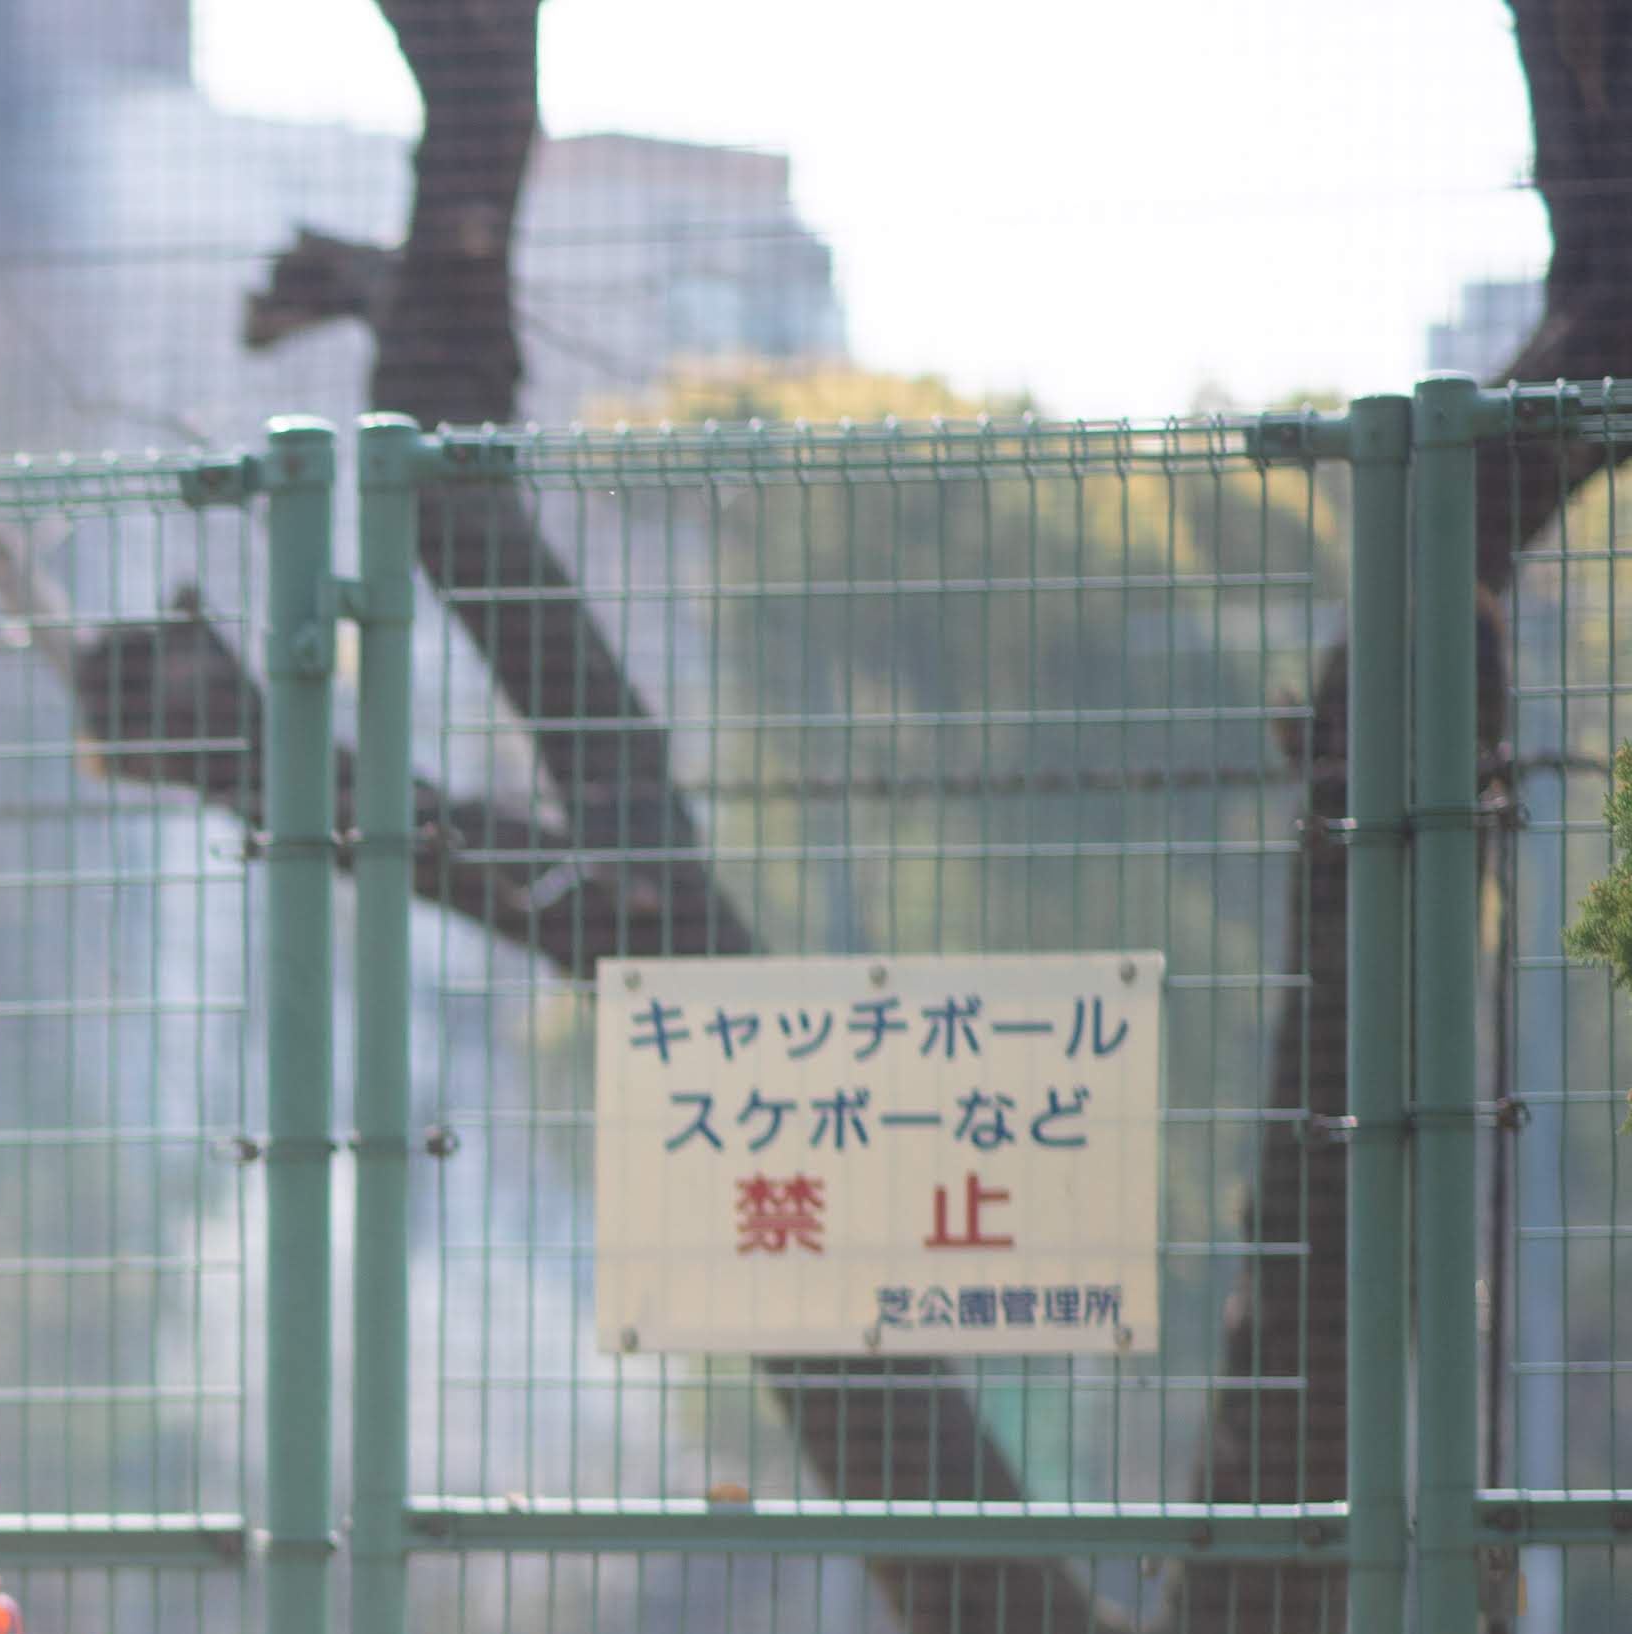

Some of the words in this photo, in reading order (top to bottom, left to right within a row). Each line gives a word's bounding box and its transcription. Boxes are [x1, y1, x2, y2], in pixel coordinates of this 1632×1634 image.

[629, 995, 1130, 1063] キャッチボール
[663, 1087, 1091, 1152] スケボーなど
